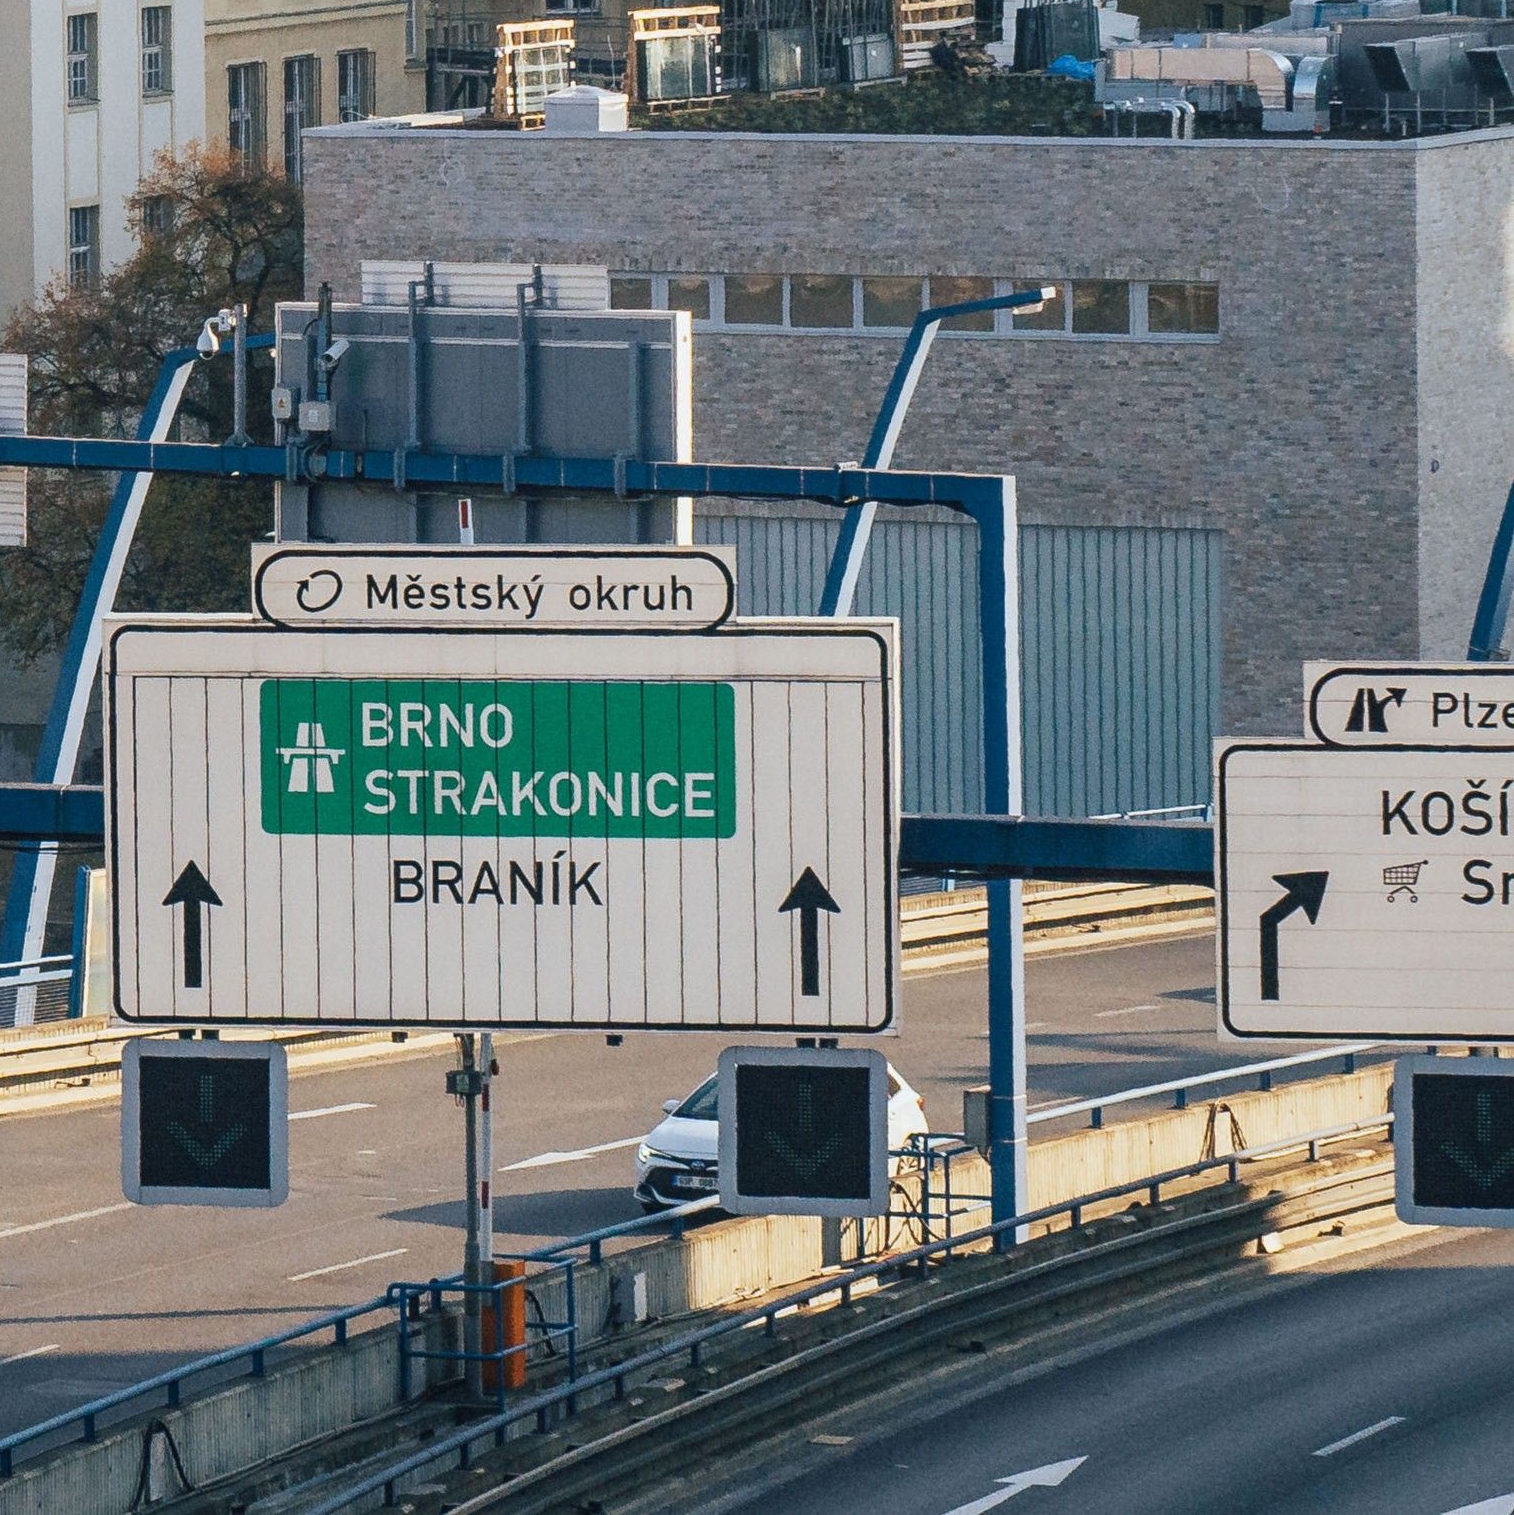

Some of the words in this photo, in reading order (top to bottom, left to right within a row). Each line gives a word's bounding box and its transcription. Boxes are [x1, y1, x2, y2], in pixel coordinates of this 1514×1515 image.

[367, 572, 544, 620] Městský
[570, 575, 692, 611] okruh
[362, 702, 513, 748] BRNO
[364, 769, 715, 818] STRAKONICE
[1382, 779, 1514, 836] KOŠÍ
[394, 851, 602, 906] BRANÍK
